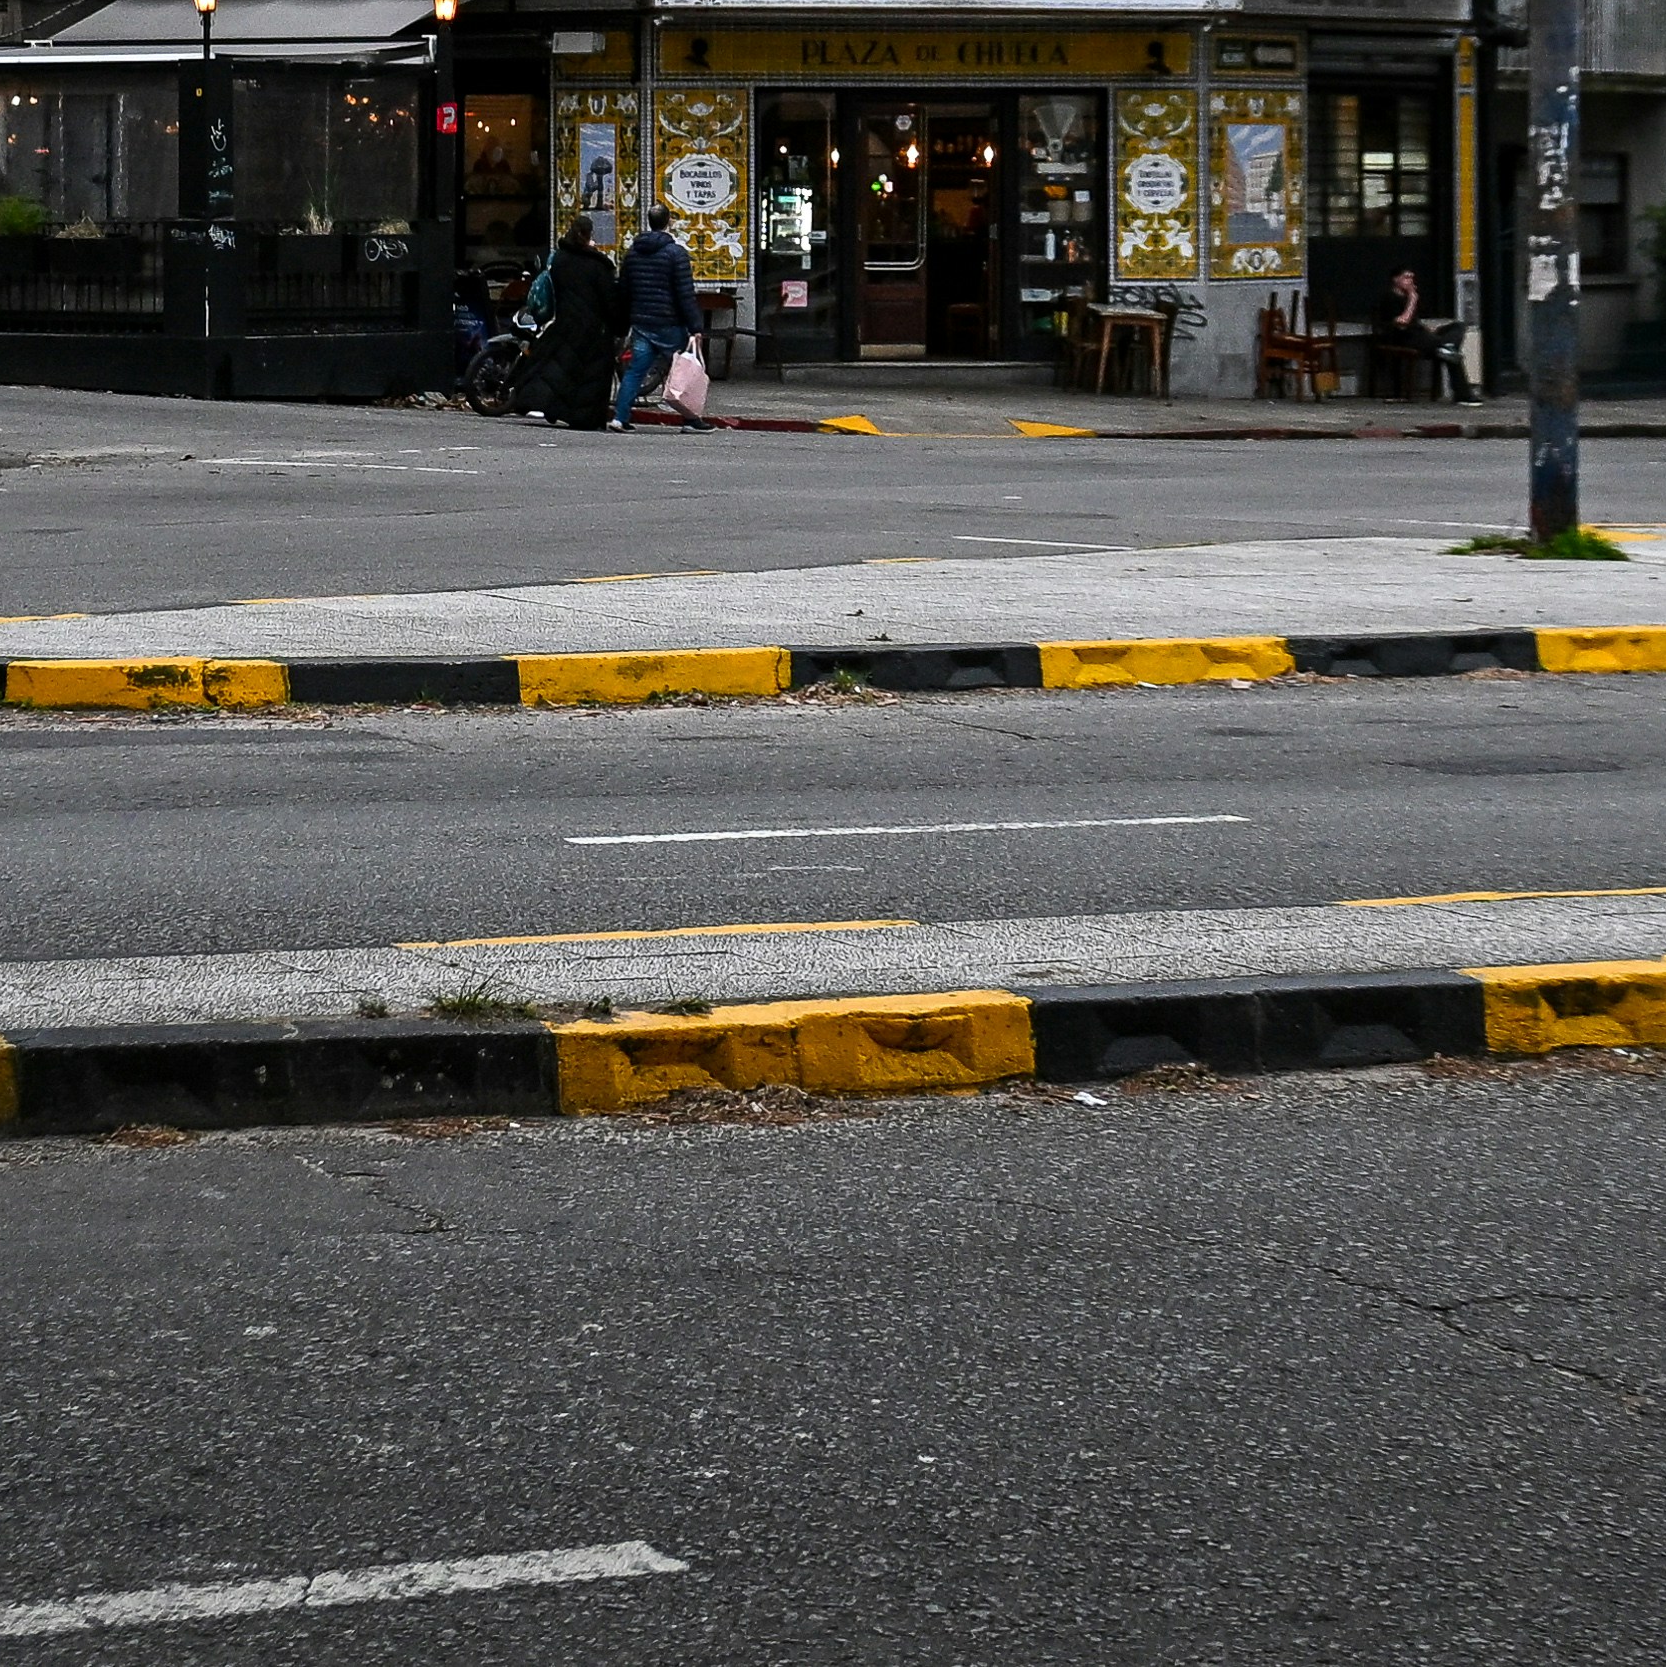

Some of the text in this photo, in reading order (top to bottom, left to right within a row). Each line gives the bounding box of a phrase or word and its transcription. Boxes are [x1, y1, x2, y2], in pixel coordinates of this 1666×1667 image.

[801, 40, 1070, 66] PLAZA DE CHUECA
[694, 190, 716, 198] TAPAS
